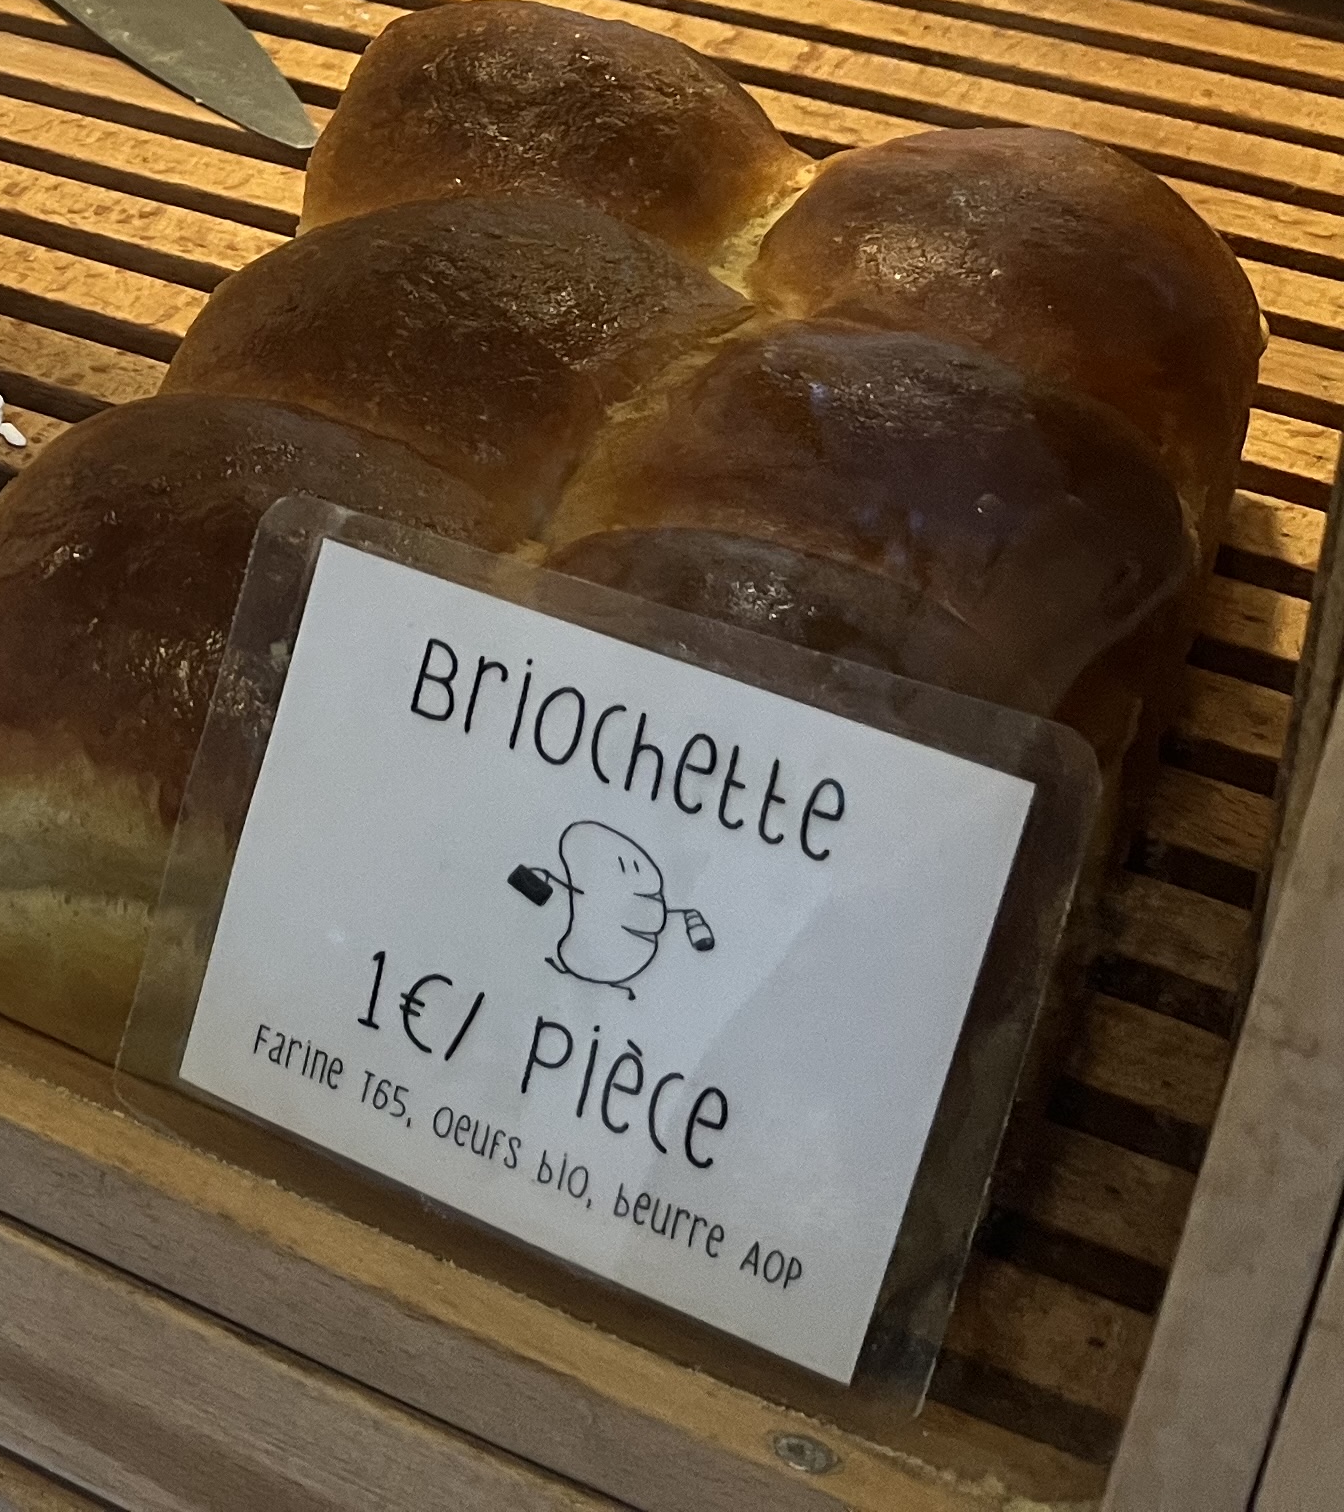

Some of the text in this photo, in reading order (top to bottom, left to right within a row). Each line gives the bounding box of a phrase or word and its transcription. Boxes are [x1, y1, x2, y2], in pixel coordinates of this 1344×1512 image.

[410, 638, 846, 862] Briochette
[357, 950, 486, 1061] 1€/
[253, 1023, 345, 1090] Farine
[360, 1070, 412, 1128] T65,
[613, 1182, 726, 1259] beurre
[739, 1240, 803, 1290] AOP
